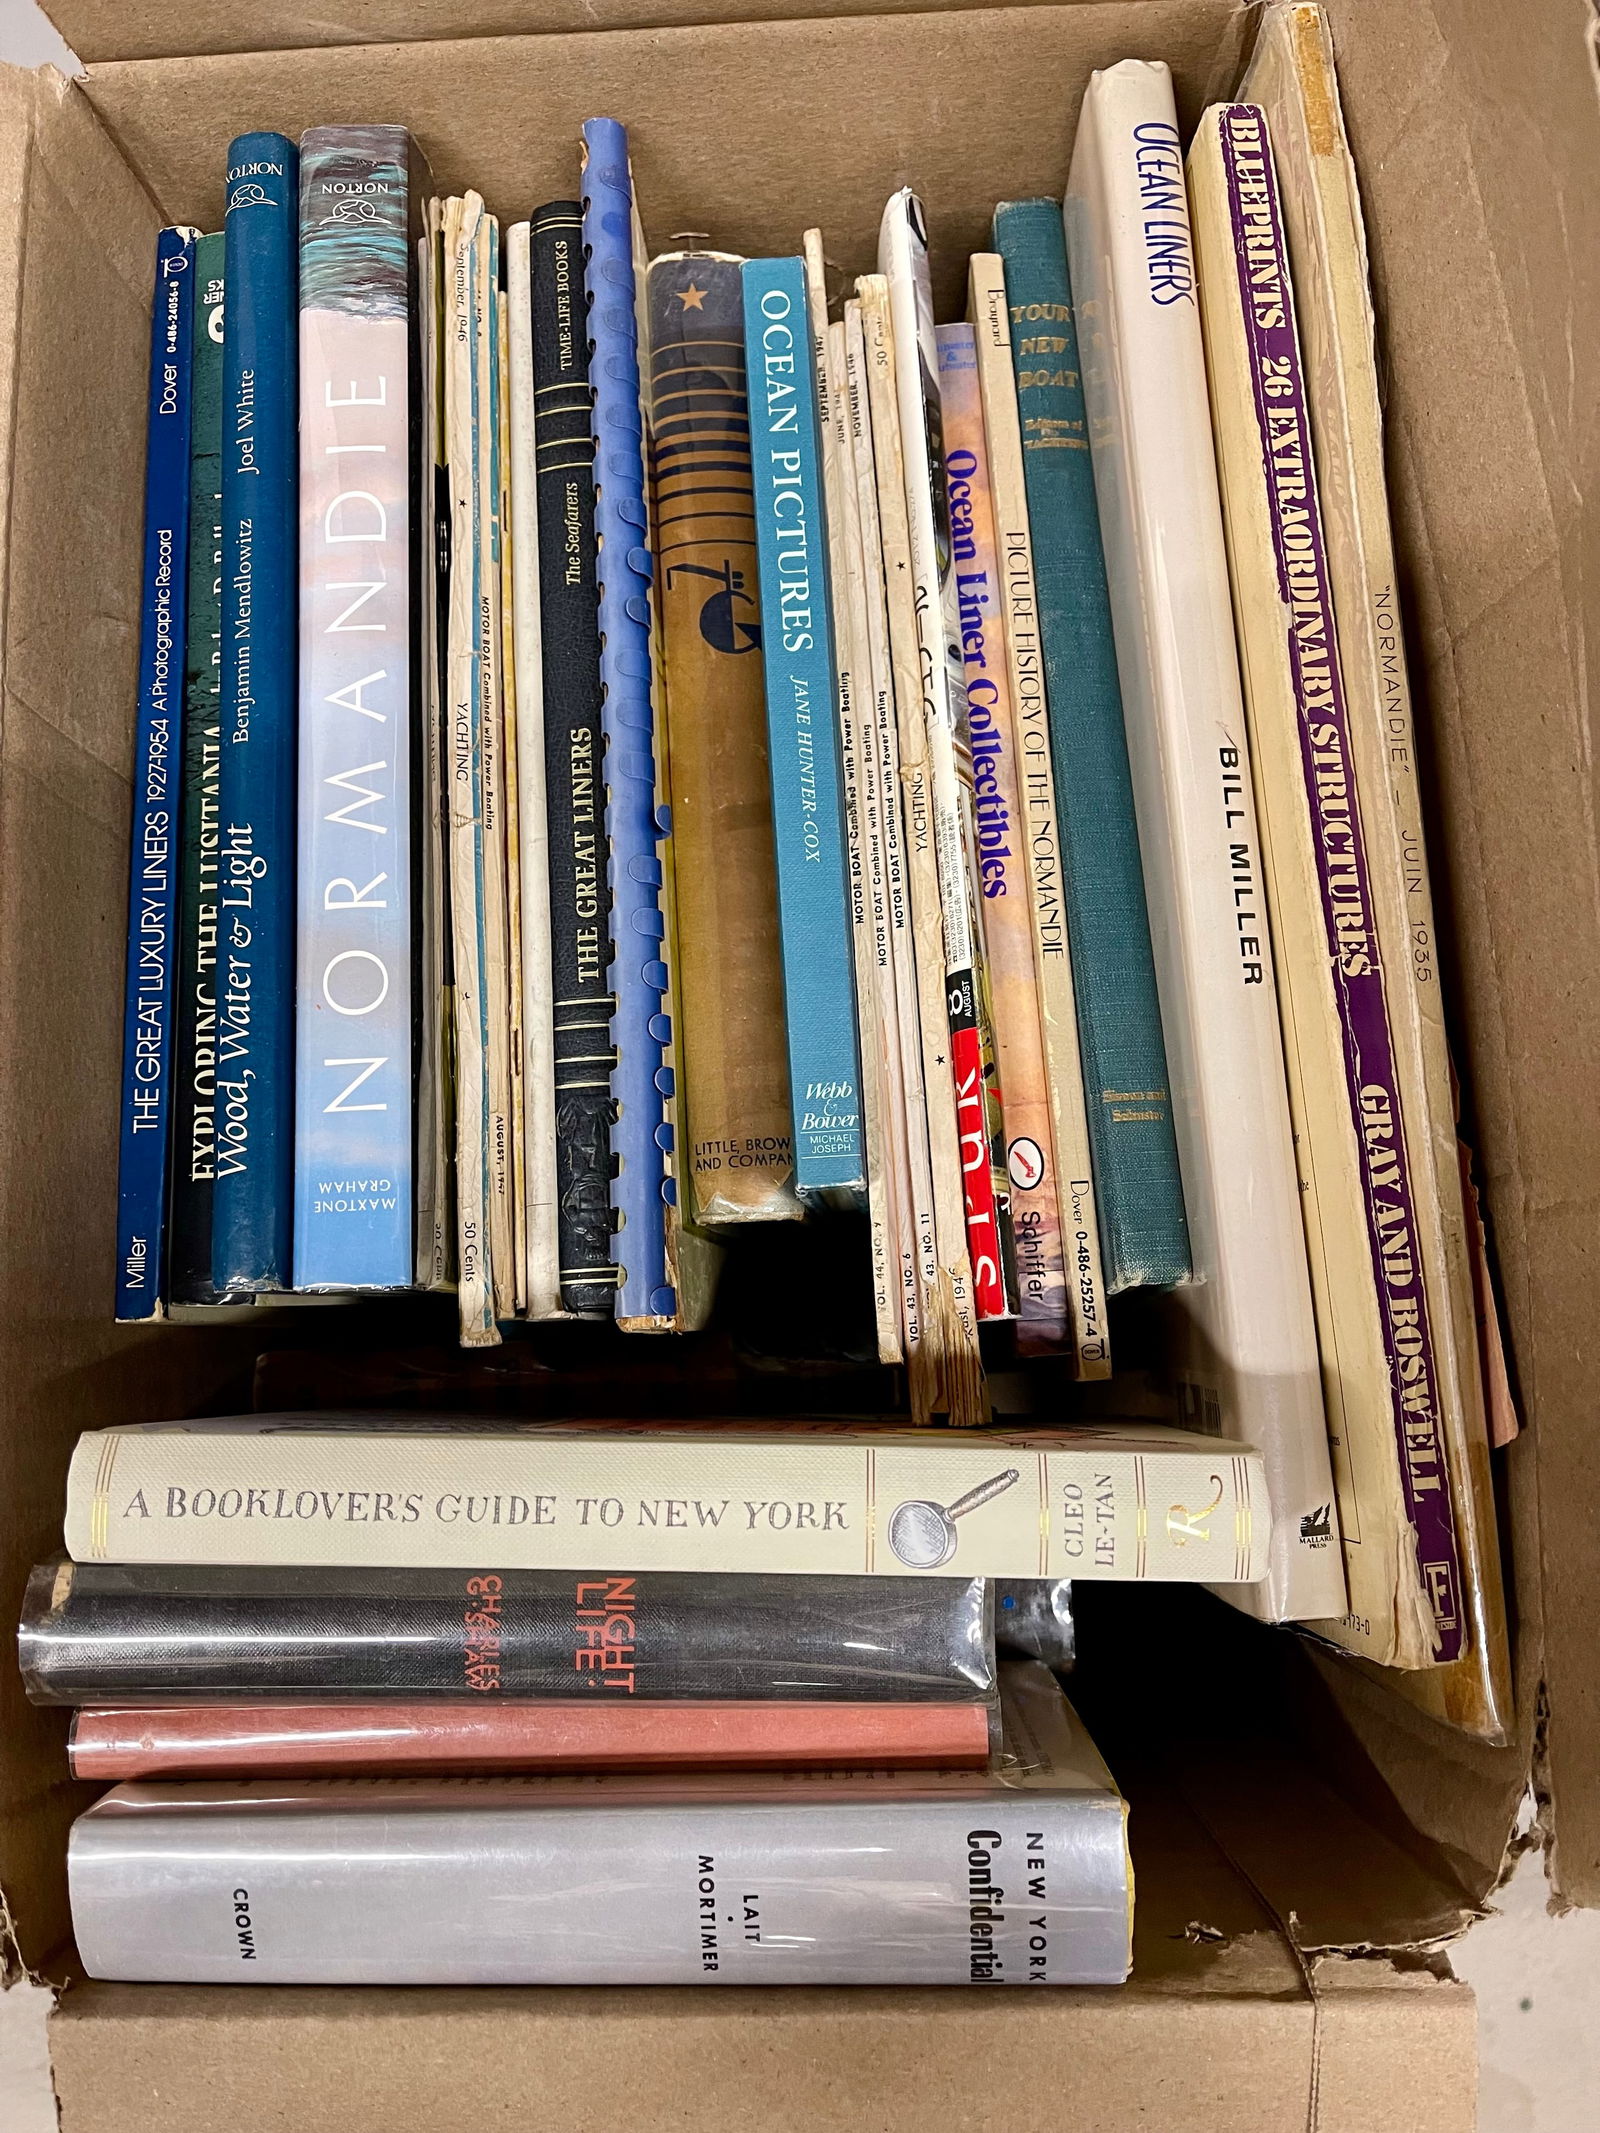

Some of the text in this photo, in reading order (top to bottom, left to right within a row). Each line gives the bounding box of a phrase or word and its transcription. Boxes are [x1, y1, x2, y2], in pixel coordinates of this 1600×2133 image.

[321, 182, 388, 195] NORTON
[1133, 122, 1195, 306] OCEAN LINERS
[555, 240, 573, 371] TIME-LIFE BOOKS
[1010, 303, 1071, 324] YOUR
[1018, 369, 1078, 389] BOAT
[1019, 336, 1070, 356] NEW
[159, 363, 177, 414] Dover
[237, 369, 260, 475] Joel White
[760, 289, 814, 653] OCEAN PICTURES
[564, 482, 582, 585] The Seafarers
[1230, 117, 1373, 979] BLUEPRINTS 26 EXTRAORDINARY STRUCTURES
[233, 518, 255, 744] Benjamin Mendlowitz
[789, 675, 812, 726] JANE
[839, 671, 850, 712] Boating
[947, 449, 1013, 900] Ocean Liner Collectibles
[322, 375, 390, 1113] NORMANDIE
[456, 702, 469, 782] YACHTING
[481, 596, 494, 830] MOTOR BOAT Combined with Power Boating
[843, 718, 853, 751] Power
[1006, 532, 1064, 961] PICTURE HISTORY OF THE NORMANDIE
[845, 756, 855, 781] with
[133, 529, 173, 1134] THE GREAT LUXURY LINERS 1927-1954 A Photographic Record
[861, 723, 887, 967] MOTOR BOAT Combined with Power Boating
[877, 690, 904, 929] MOTOR BOAT Combined with Power Boating
[911, 772, 928, 853] YACHTING
[570, 727, 599, 983] THE GREAT LINERS
[851, 846, 862, 877] BOAT
[1219, 747, 1263, 985] BILL MILLER
[852, 881, 864, 925] MOTOR
[1401, 828, 1423, 895] JUIN
[1412, 920, 1433, 983] 1935
[217, 822, 267, 1180] Wood, Water & Light
[961, 979, 973, 1018] AUGUST
[801, 1112, 859, 1131] Bower
[805, 1081, 853, 1100] Webb
[823, 1099, 838, 1116] &
[695, 1139, 740, 1156] LITTLE,
[695, 1157, 722, 1172] AND
[809, 1134, 855, 1144] MICHAEL
[811, 1144, 851, 1154] JOSEPH
[314, 1198, 396, 1213] MAXTONE
[318, 1179, 392, 1194] GRAHAM
[1070, 1179, 1090, 1225] Dover
[126, 1235, 147, 1289] Miller
[464, 1222, 478, 1283] 50 Cents
[920, 1213, 933, 1253] NO. 11
[1021, 1211, 1047, 1302] Schiffer
[903, 1265, 914, 1287] NO.
[1075, 1231, 1098, 1338] 0-486-25257-4
[1360, 1083, 1441, 1503] GRAY AND BOSWELL
[909, 1315, 919, 1343] VOL.
[123, 1486, 851, 1531] A BOOKLOVER'S GUIDE TO NEW YORK
[1063, 1483, 1084, 1557] CLEO
[1166, 1474, 1223, 1548] R
[1299, 1535, 1334, 1545] MALLARD
[464, 1611, 483, 1691] SHAW
[479, 1575, 503, 1692] CHARLES
[603, 1577, 637, 1694] NIGHT
[233, 1888, 256, 1959] CROWN
[698, 1855, 719, 1971] MORTIMER
[743, 1894, 761, 1942] LAIT
[967, 1829, 1005, 1983] Confidential
[1026, 1833, 1047, 1981] NEW YORK
